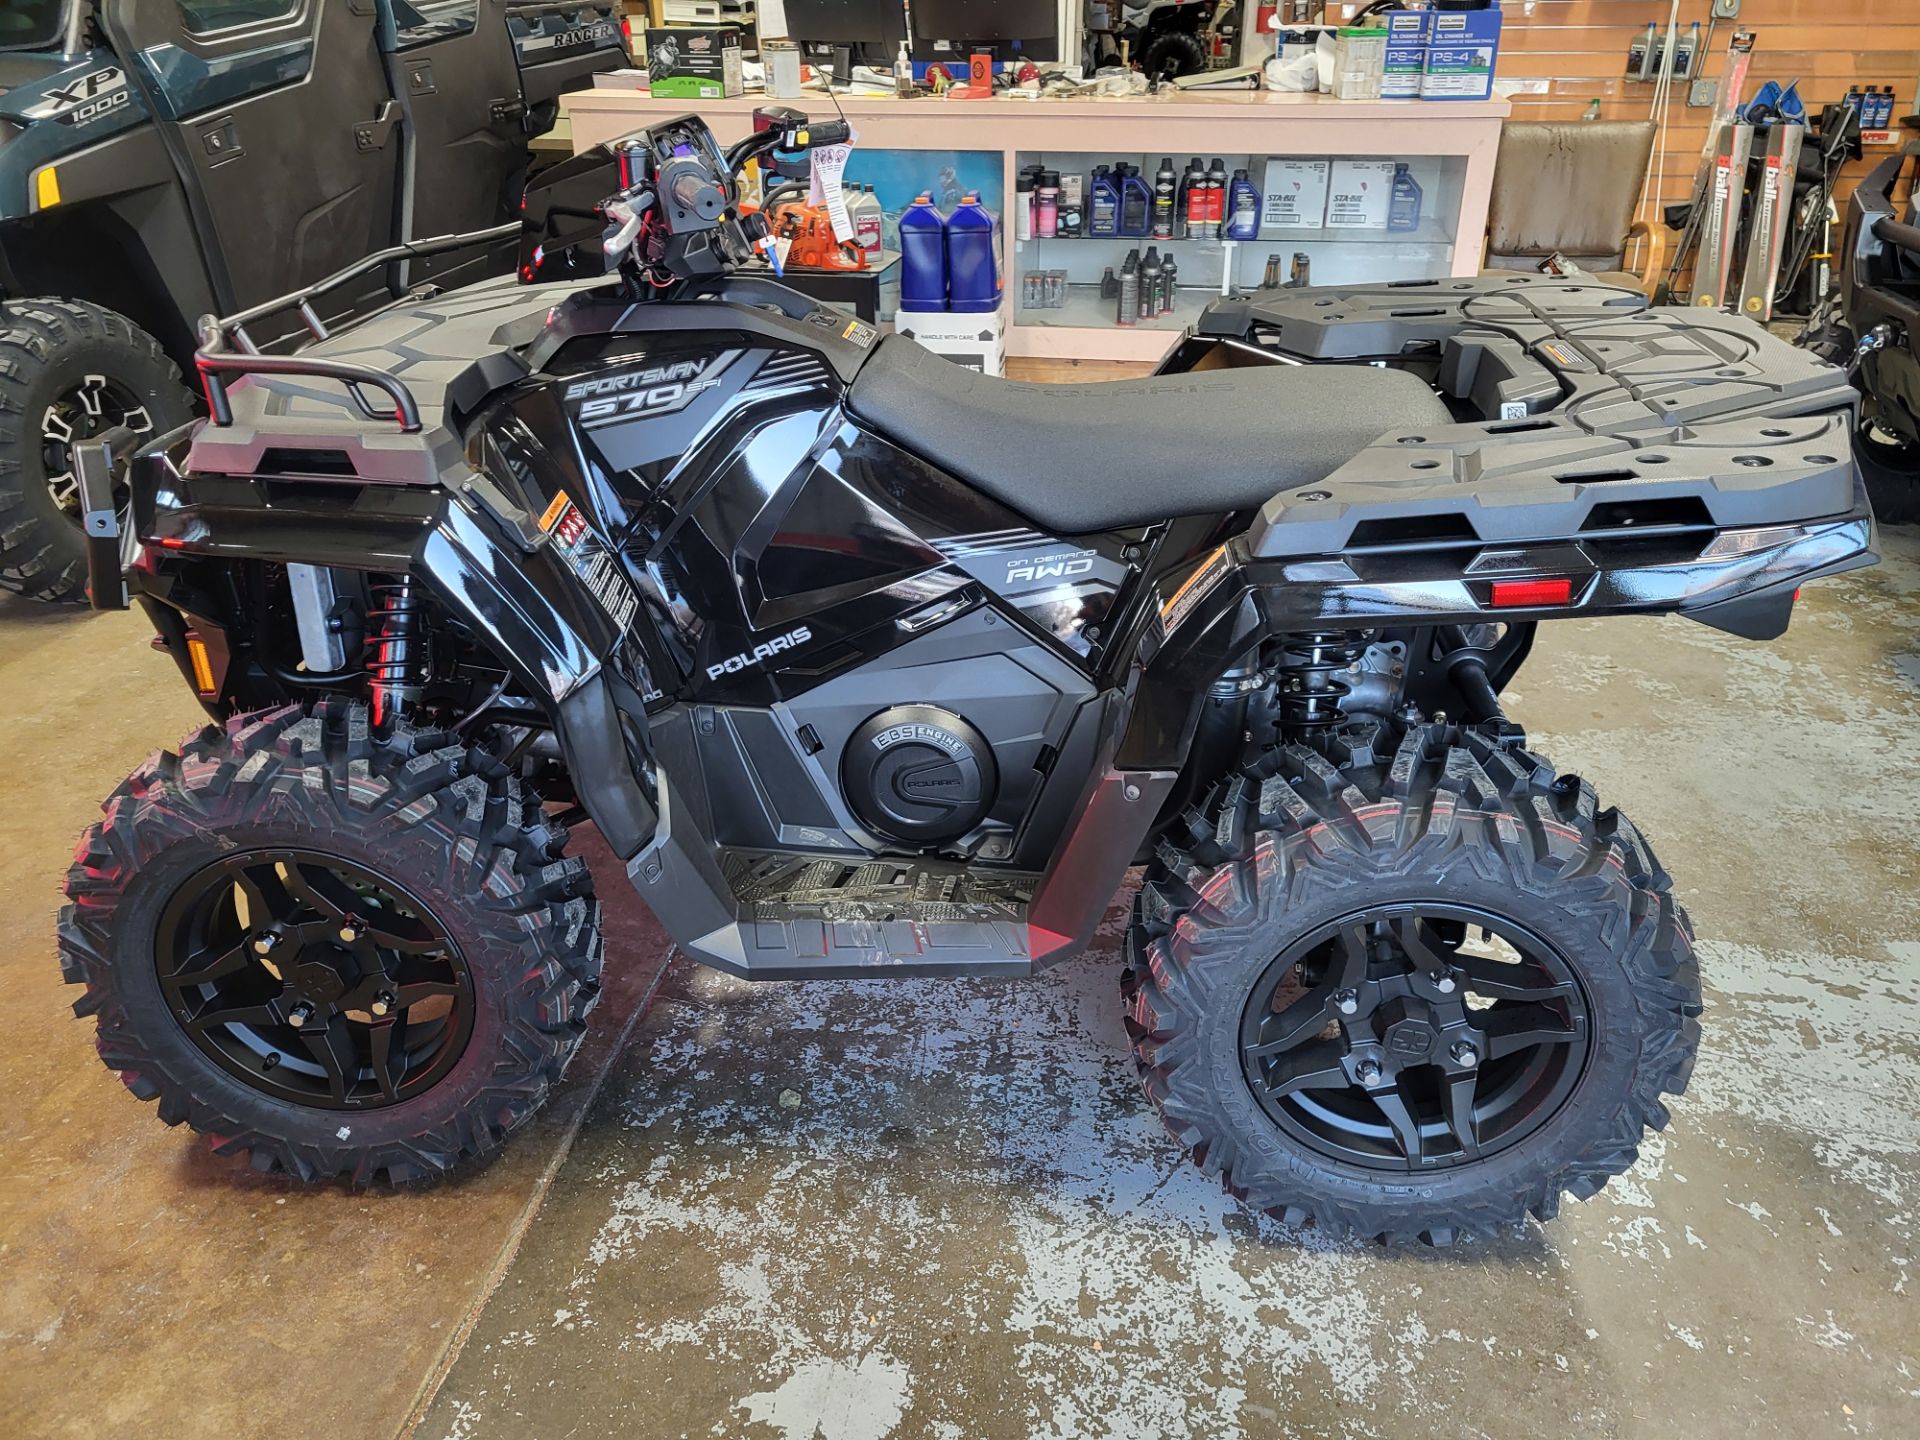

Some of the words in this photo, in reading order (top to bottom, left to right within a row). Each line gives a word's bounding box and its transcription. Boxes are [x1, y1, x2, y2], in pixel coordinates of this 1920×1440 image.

[553, 24, 610, 48] RANGER
[1388, 52, 1423, 62] PS-4
[1433, 52, 1469, 62] PS-4
[44, 67, 120, 110] XP
[72, 90, 128, 123] 1000
[564, 358, 707, 401] SPORTSMAN
[579, 383, 685, 422] 570
[685, 376, 722, 393] EFI
[1006, 558, 1093, 584] AWD
[1007, 560, 1028, 568] ON
[1034, 549, 1097, 564] DEMAND
[705, 626, 812, 681] POLARIS
[877, 726, 913, 747] EBS
[917, 727, 962, 751] ENGINE
[906, 779, 961, 788] POLARIS
